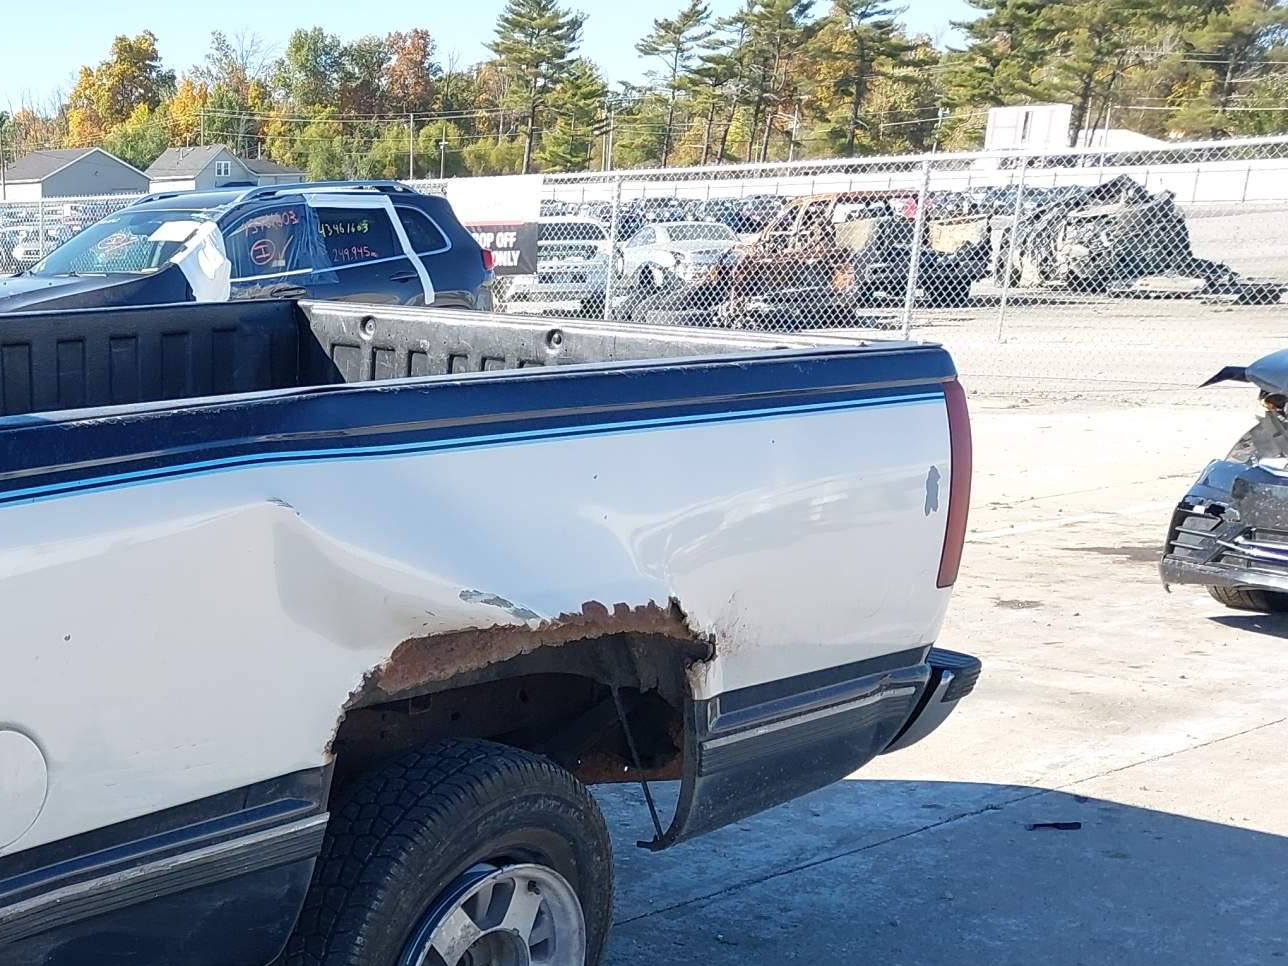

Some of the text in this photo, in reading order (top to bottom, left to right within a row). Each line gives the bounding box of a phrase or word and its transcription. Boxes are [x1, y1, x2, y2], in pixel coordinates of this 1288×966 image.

[317, 221, 369, 238] 43461603
[472, 232, 517, 248] ROP OFF
[492, 250, 520, 266] ONLY
